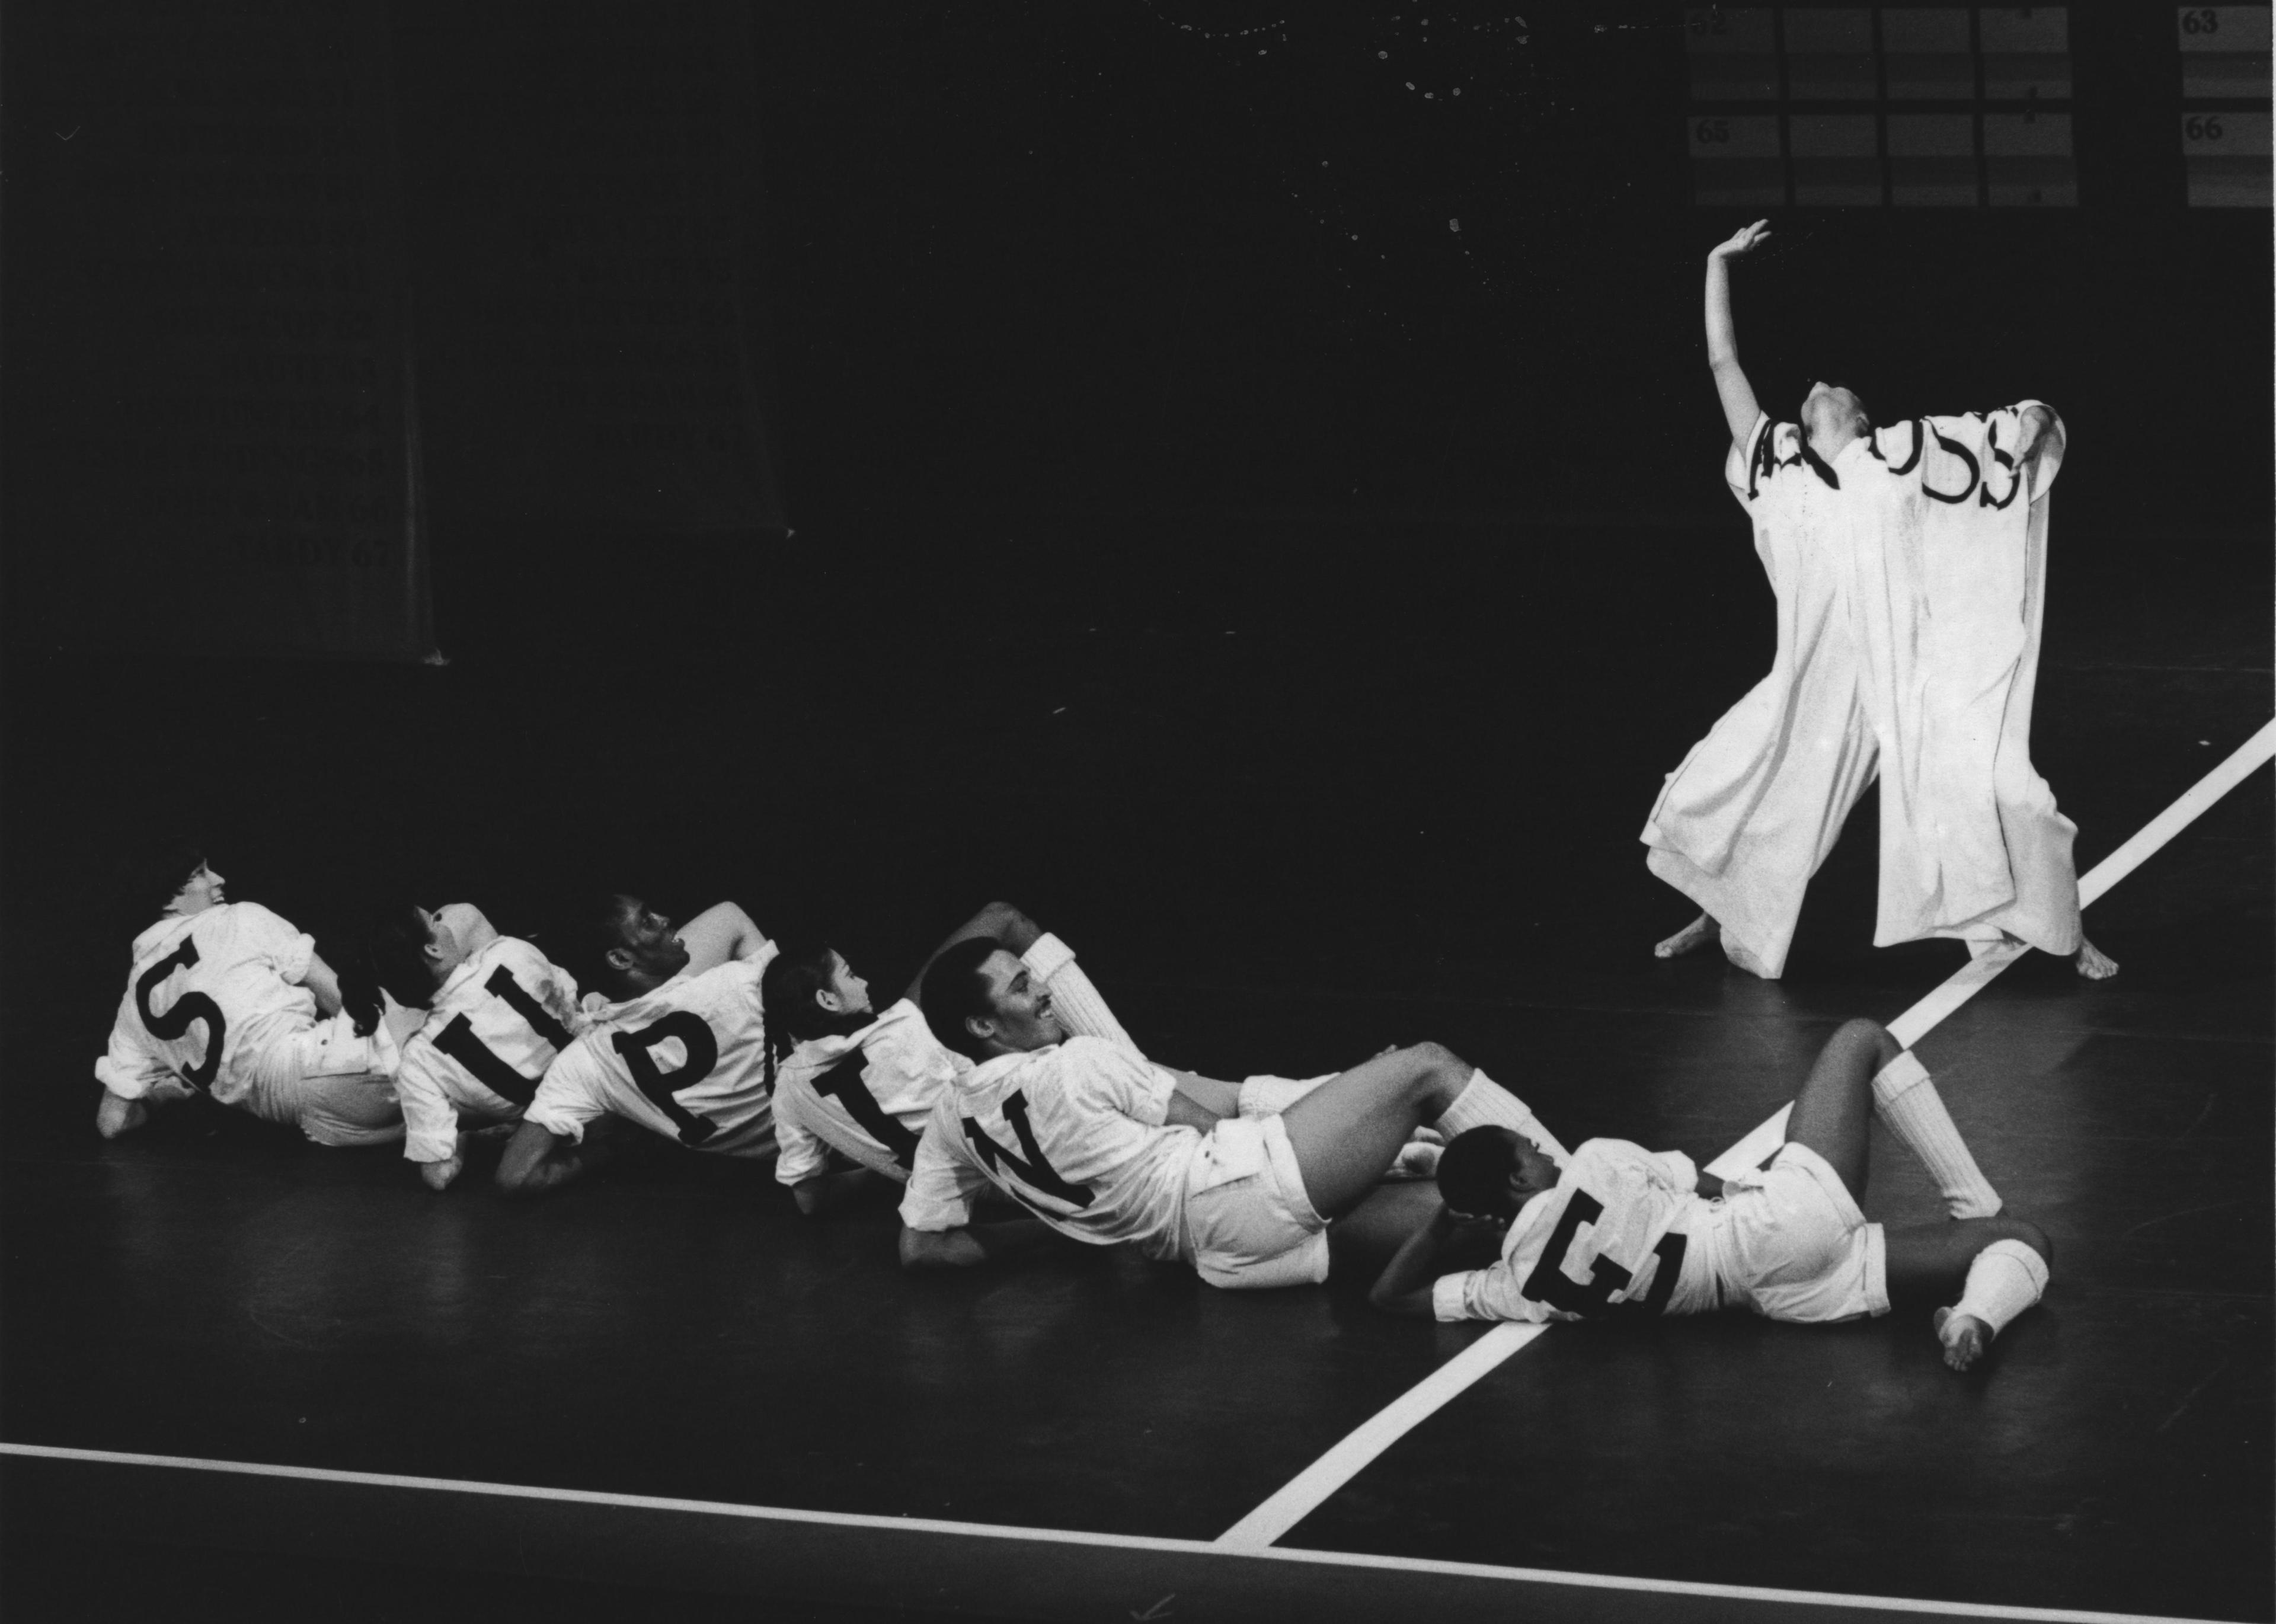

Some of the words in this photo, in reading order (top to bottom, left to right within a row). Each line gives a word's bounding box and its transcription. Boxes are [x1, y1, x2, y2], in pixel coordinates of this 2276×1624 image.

[2182, 8, 2219, 35] 63
[1695, 119, 1731, 144] 65
[2185, 115, 2223, 141] 66
[136, 934, 226, 1092] S
[612, 1011, 718, 1145] P
[962, 1088, 1096, 1221] N
[1521, 1188, 1687, 1317] E
